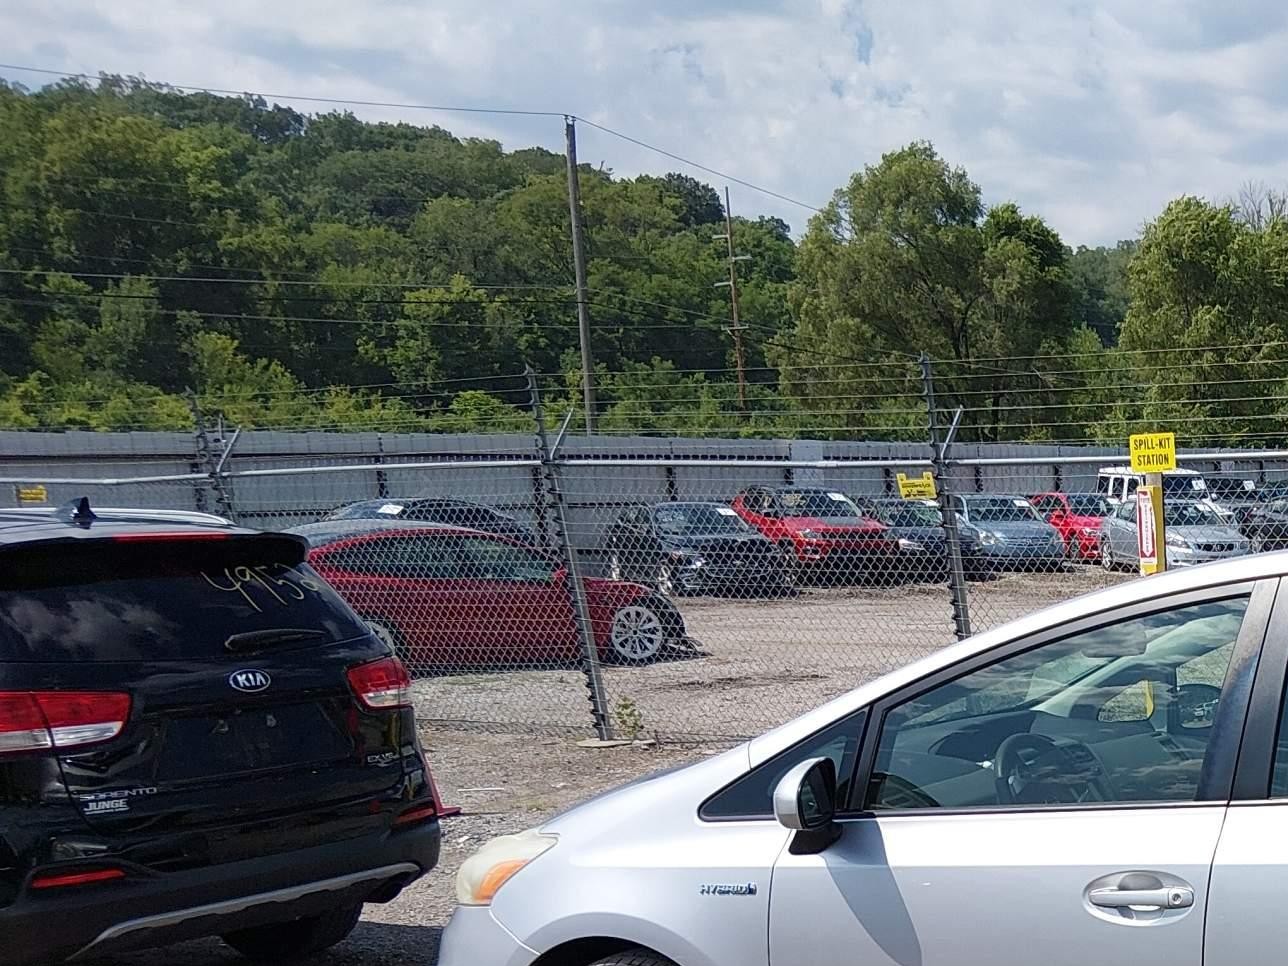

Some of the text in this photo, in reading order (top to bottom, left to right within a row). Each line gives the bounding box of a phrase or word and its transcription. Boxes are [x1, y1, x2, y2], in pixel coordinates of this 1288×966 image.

[1133, 437, 1171, 451] SPILL-KIT
[1137, 453, 1170, 466] STATION
[236, 672, 267, 687] KIA
[83, 799, 129, 811] JUNGE
